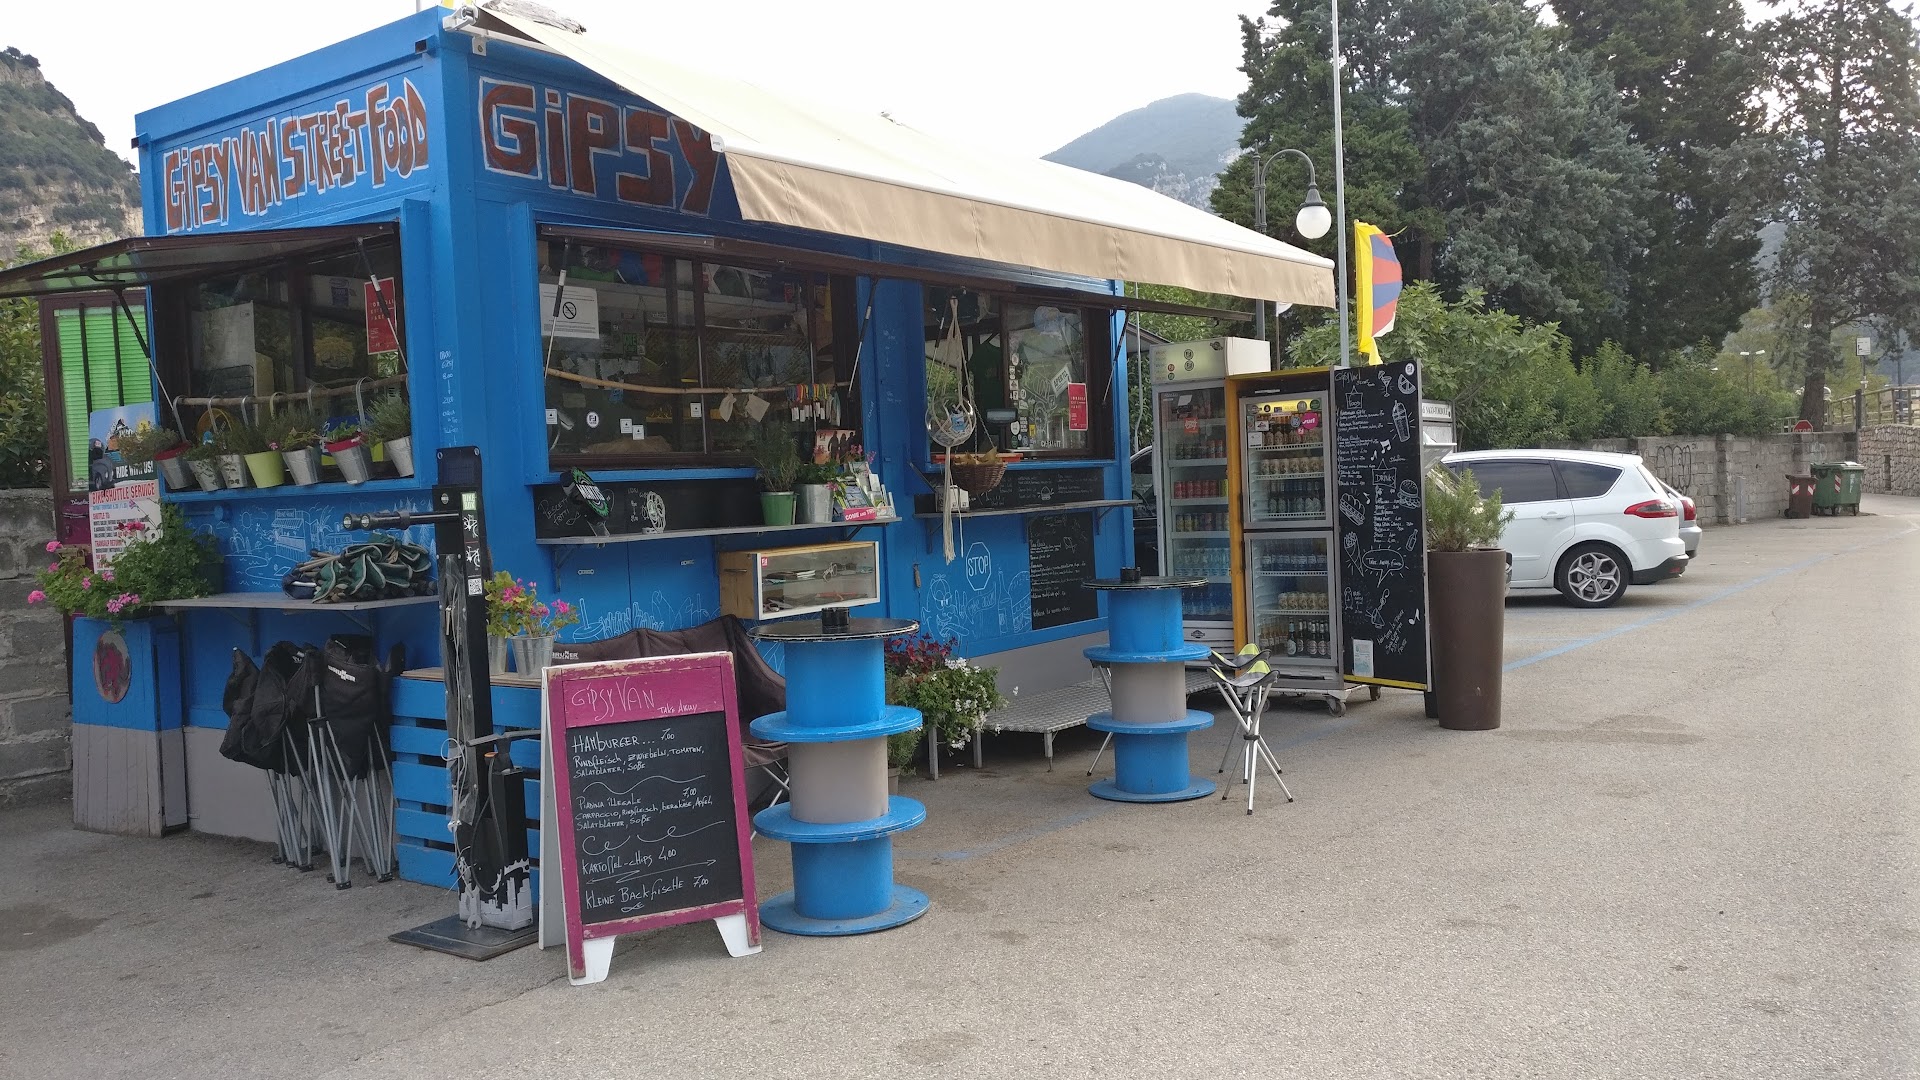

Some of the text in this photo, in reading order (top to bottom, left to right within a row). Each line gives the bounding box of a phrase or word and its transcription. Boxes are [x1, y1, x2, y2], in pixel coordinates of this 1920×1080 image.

[232, 117, 282, 217] VAN
[280, 99, 368, 201] STREET
[366, 77, 429, 189] FOOD
[115, 466, 128, 478] RIDE
[143, 460, 154, 474] US!
[93, 491, 105, 505] BIKE
[105, 486, 129, 502] SHUTTLE
[131, 482, 155, 498] SERVICE
[845, 512, 860, 521] COME
[968, 555, 989, 577] STOP
[616, 676, 655, 712] VAN
